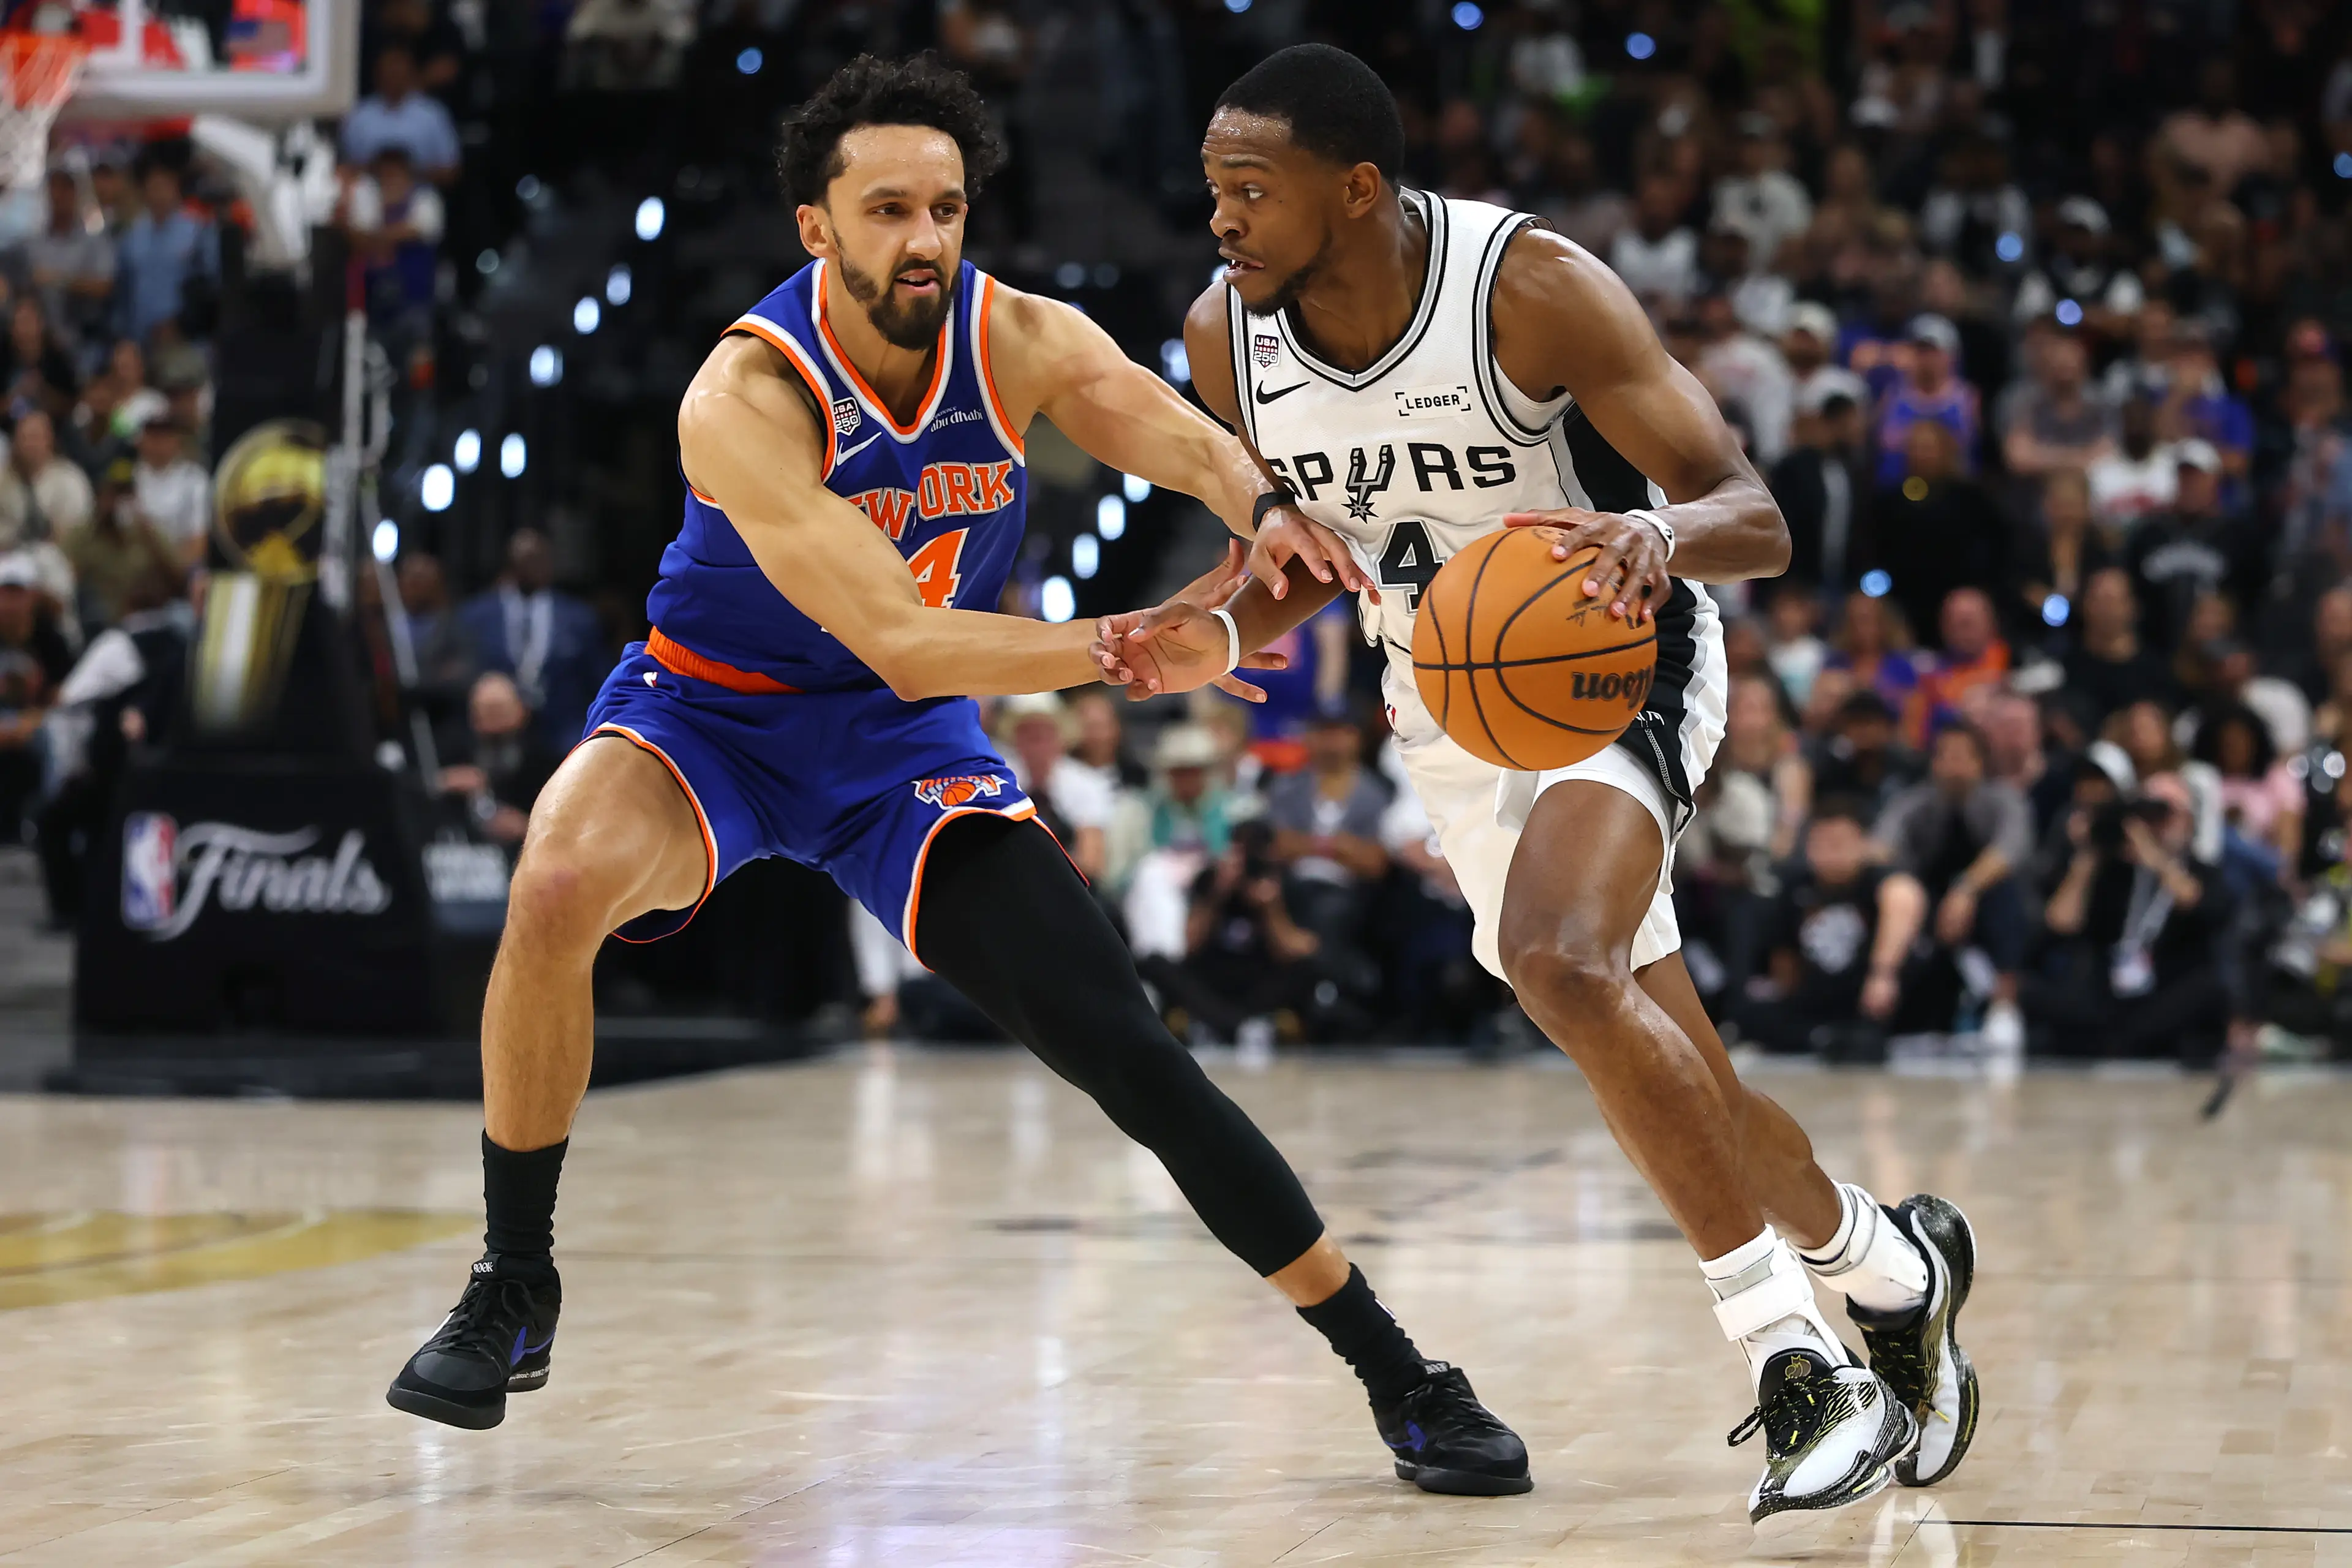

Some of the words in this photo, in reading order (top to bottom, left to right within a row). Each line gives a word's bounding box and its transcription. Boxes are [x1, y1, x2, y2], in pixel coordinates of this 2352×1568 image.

[1256, 337, 1278, 348] USA
[1253, 351, 1278, 363] 250
[1405, 394, 1461, 409] LEDGER
[835, 415, 859, 429] 250
[930, 417, 949, 432] abu
[950, 409, 984, 424] dhabi
[917, 458, 1015, 521] ORK
[1374, 518, 1449, 614] 4
[150, 821, 392, 943] Finals
